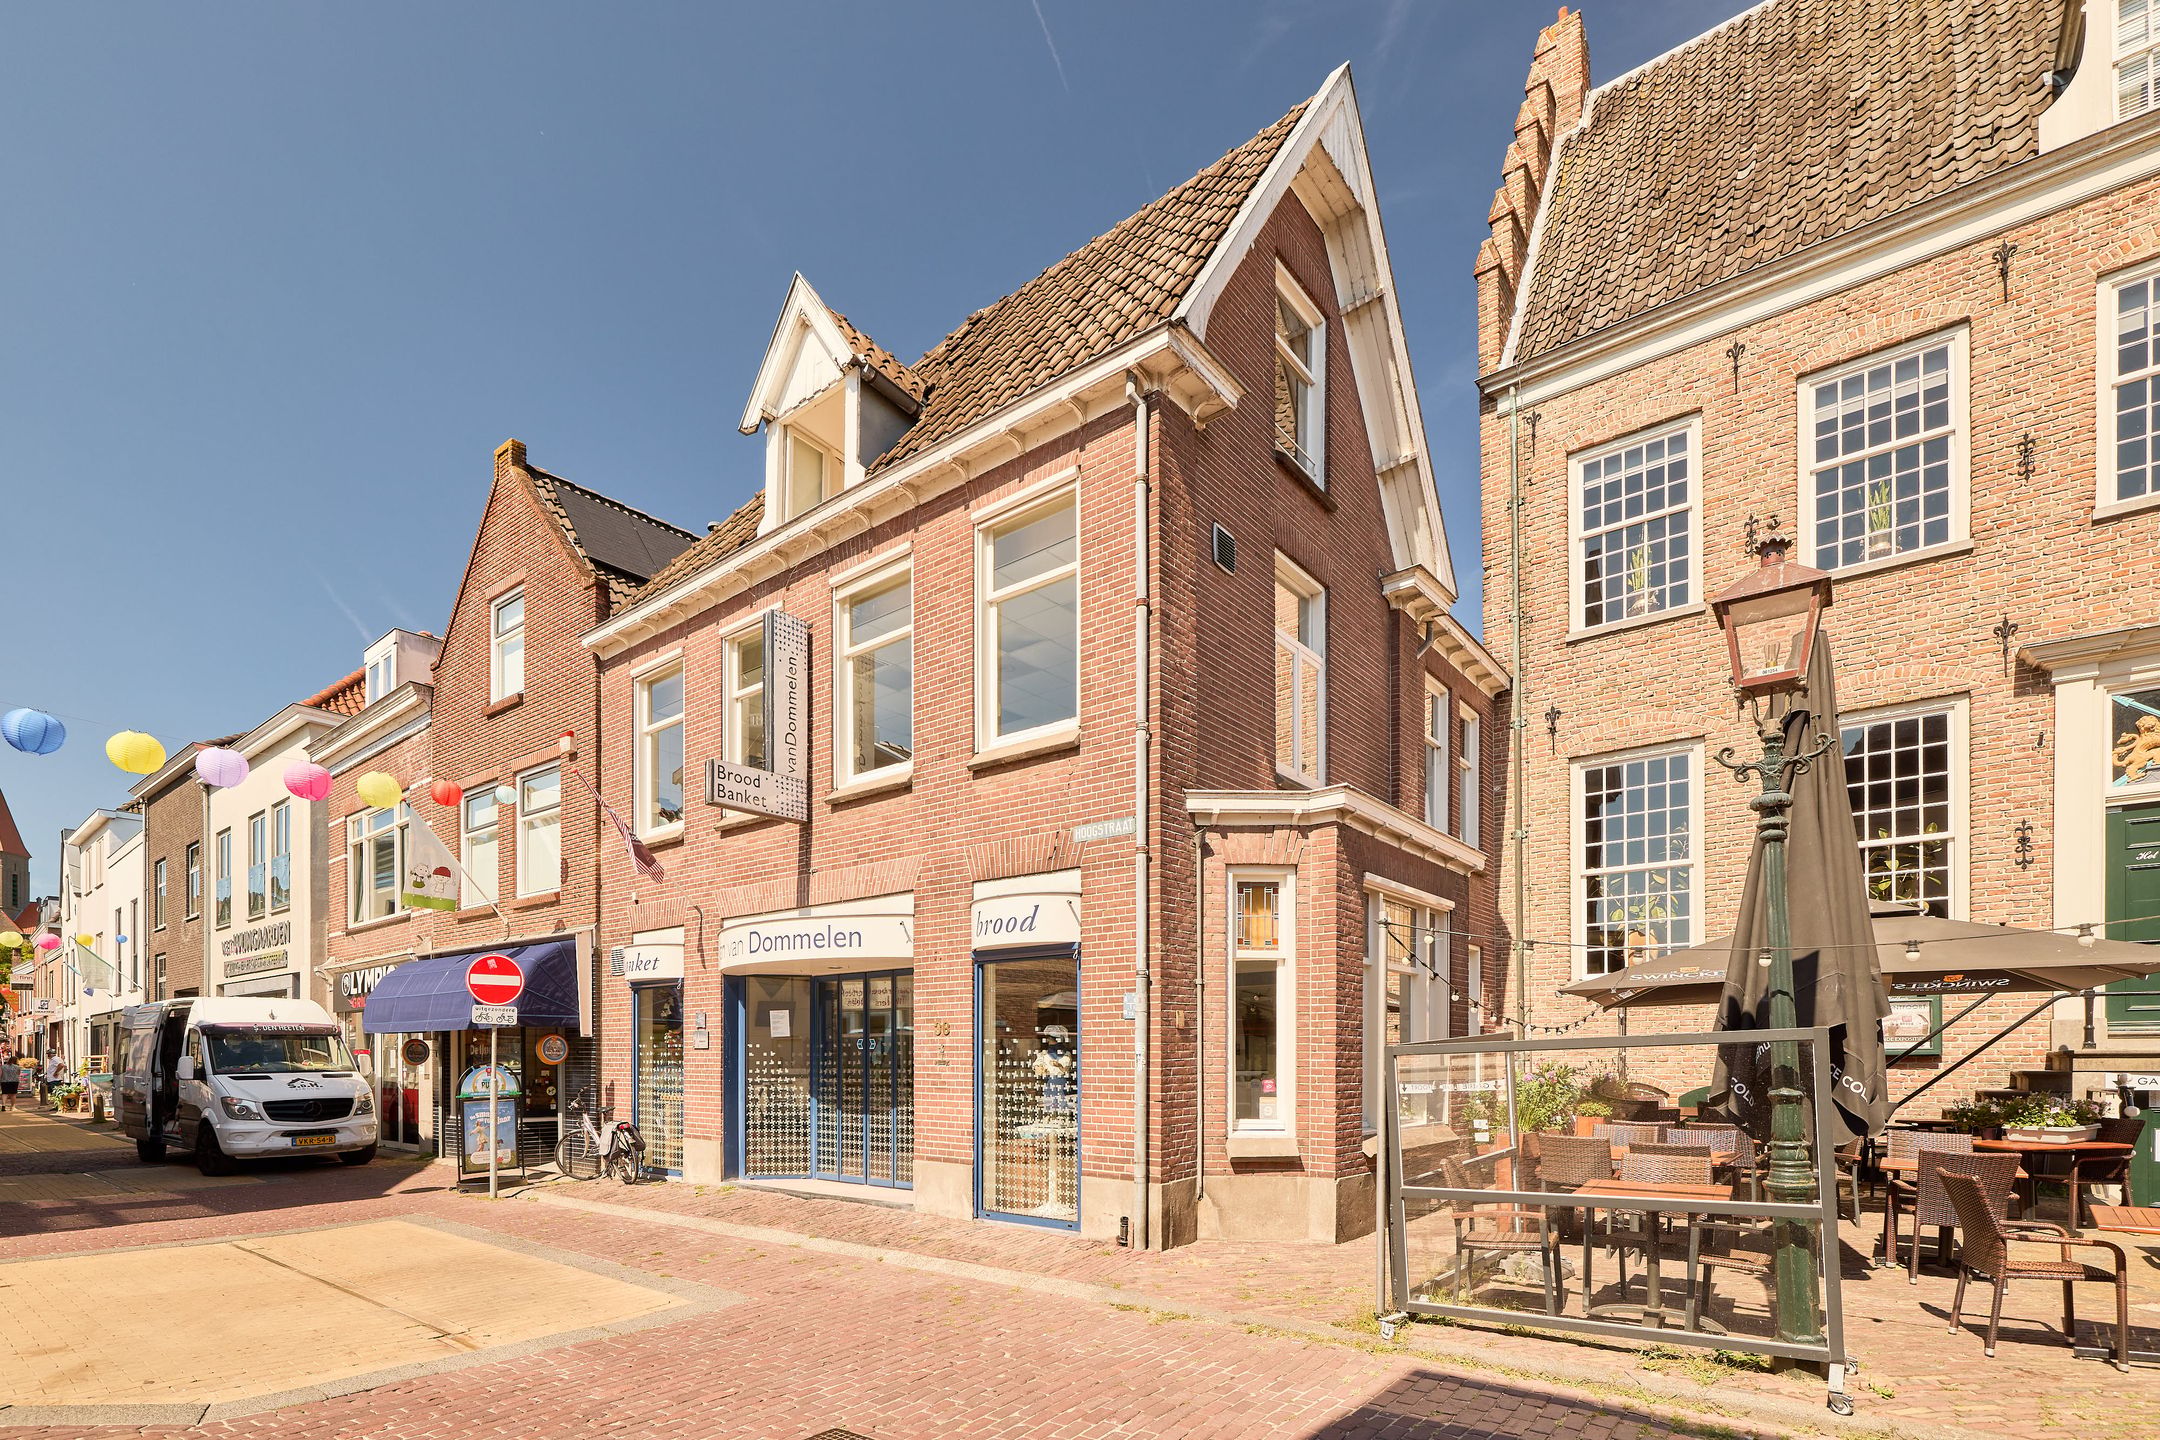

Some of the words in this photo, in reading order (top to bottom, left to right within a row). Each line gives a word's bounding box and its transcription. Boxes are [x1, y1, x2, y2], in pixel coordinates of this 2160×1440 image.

[717, 764, 761, 788] Brood
[717, 783, 767, 808] Banket
[1075, 818, 1134, 840] HOOGSTRAAT
[976, 904, 1040, 938] brood
[749, 924, 862, 954] Dommelen
